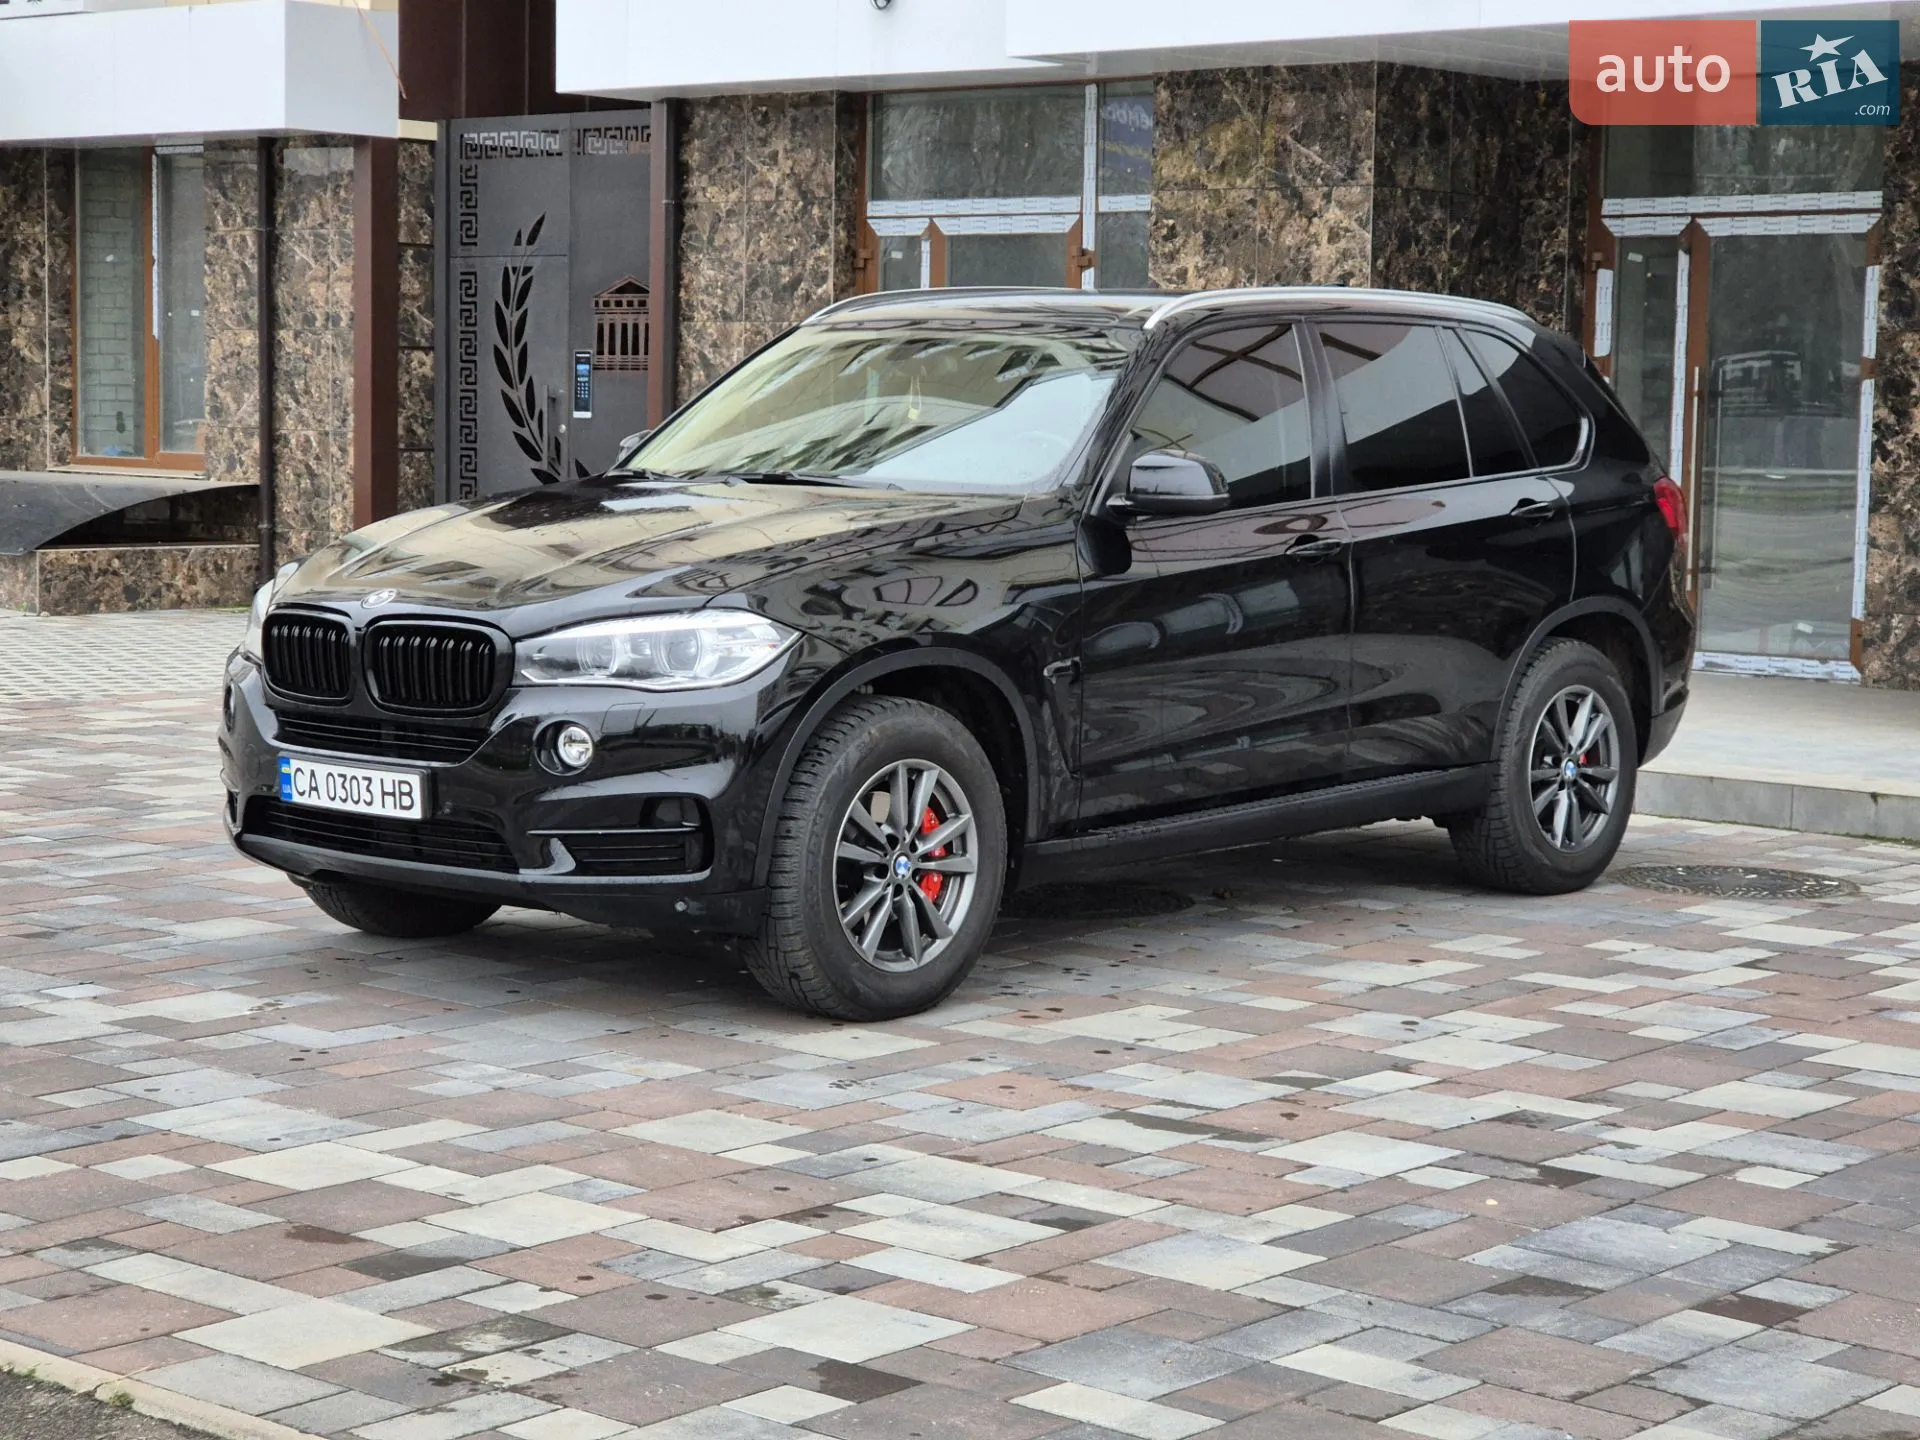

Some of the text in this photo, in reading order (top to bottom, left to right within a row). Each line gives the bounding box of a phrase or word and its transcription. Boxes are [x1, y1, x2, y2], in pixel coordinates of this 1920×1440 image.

[293, 767, 414, 810] CA 0303 HB
